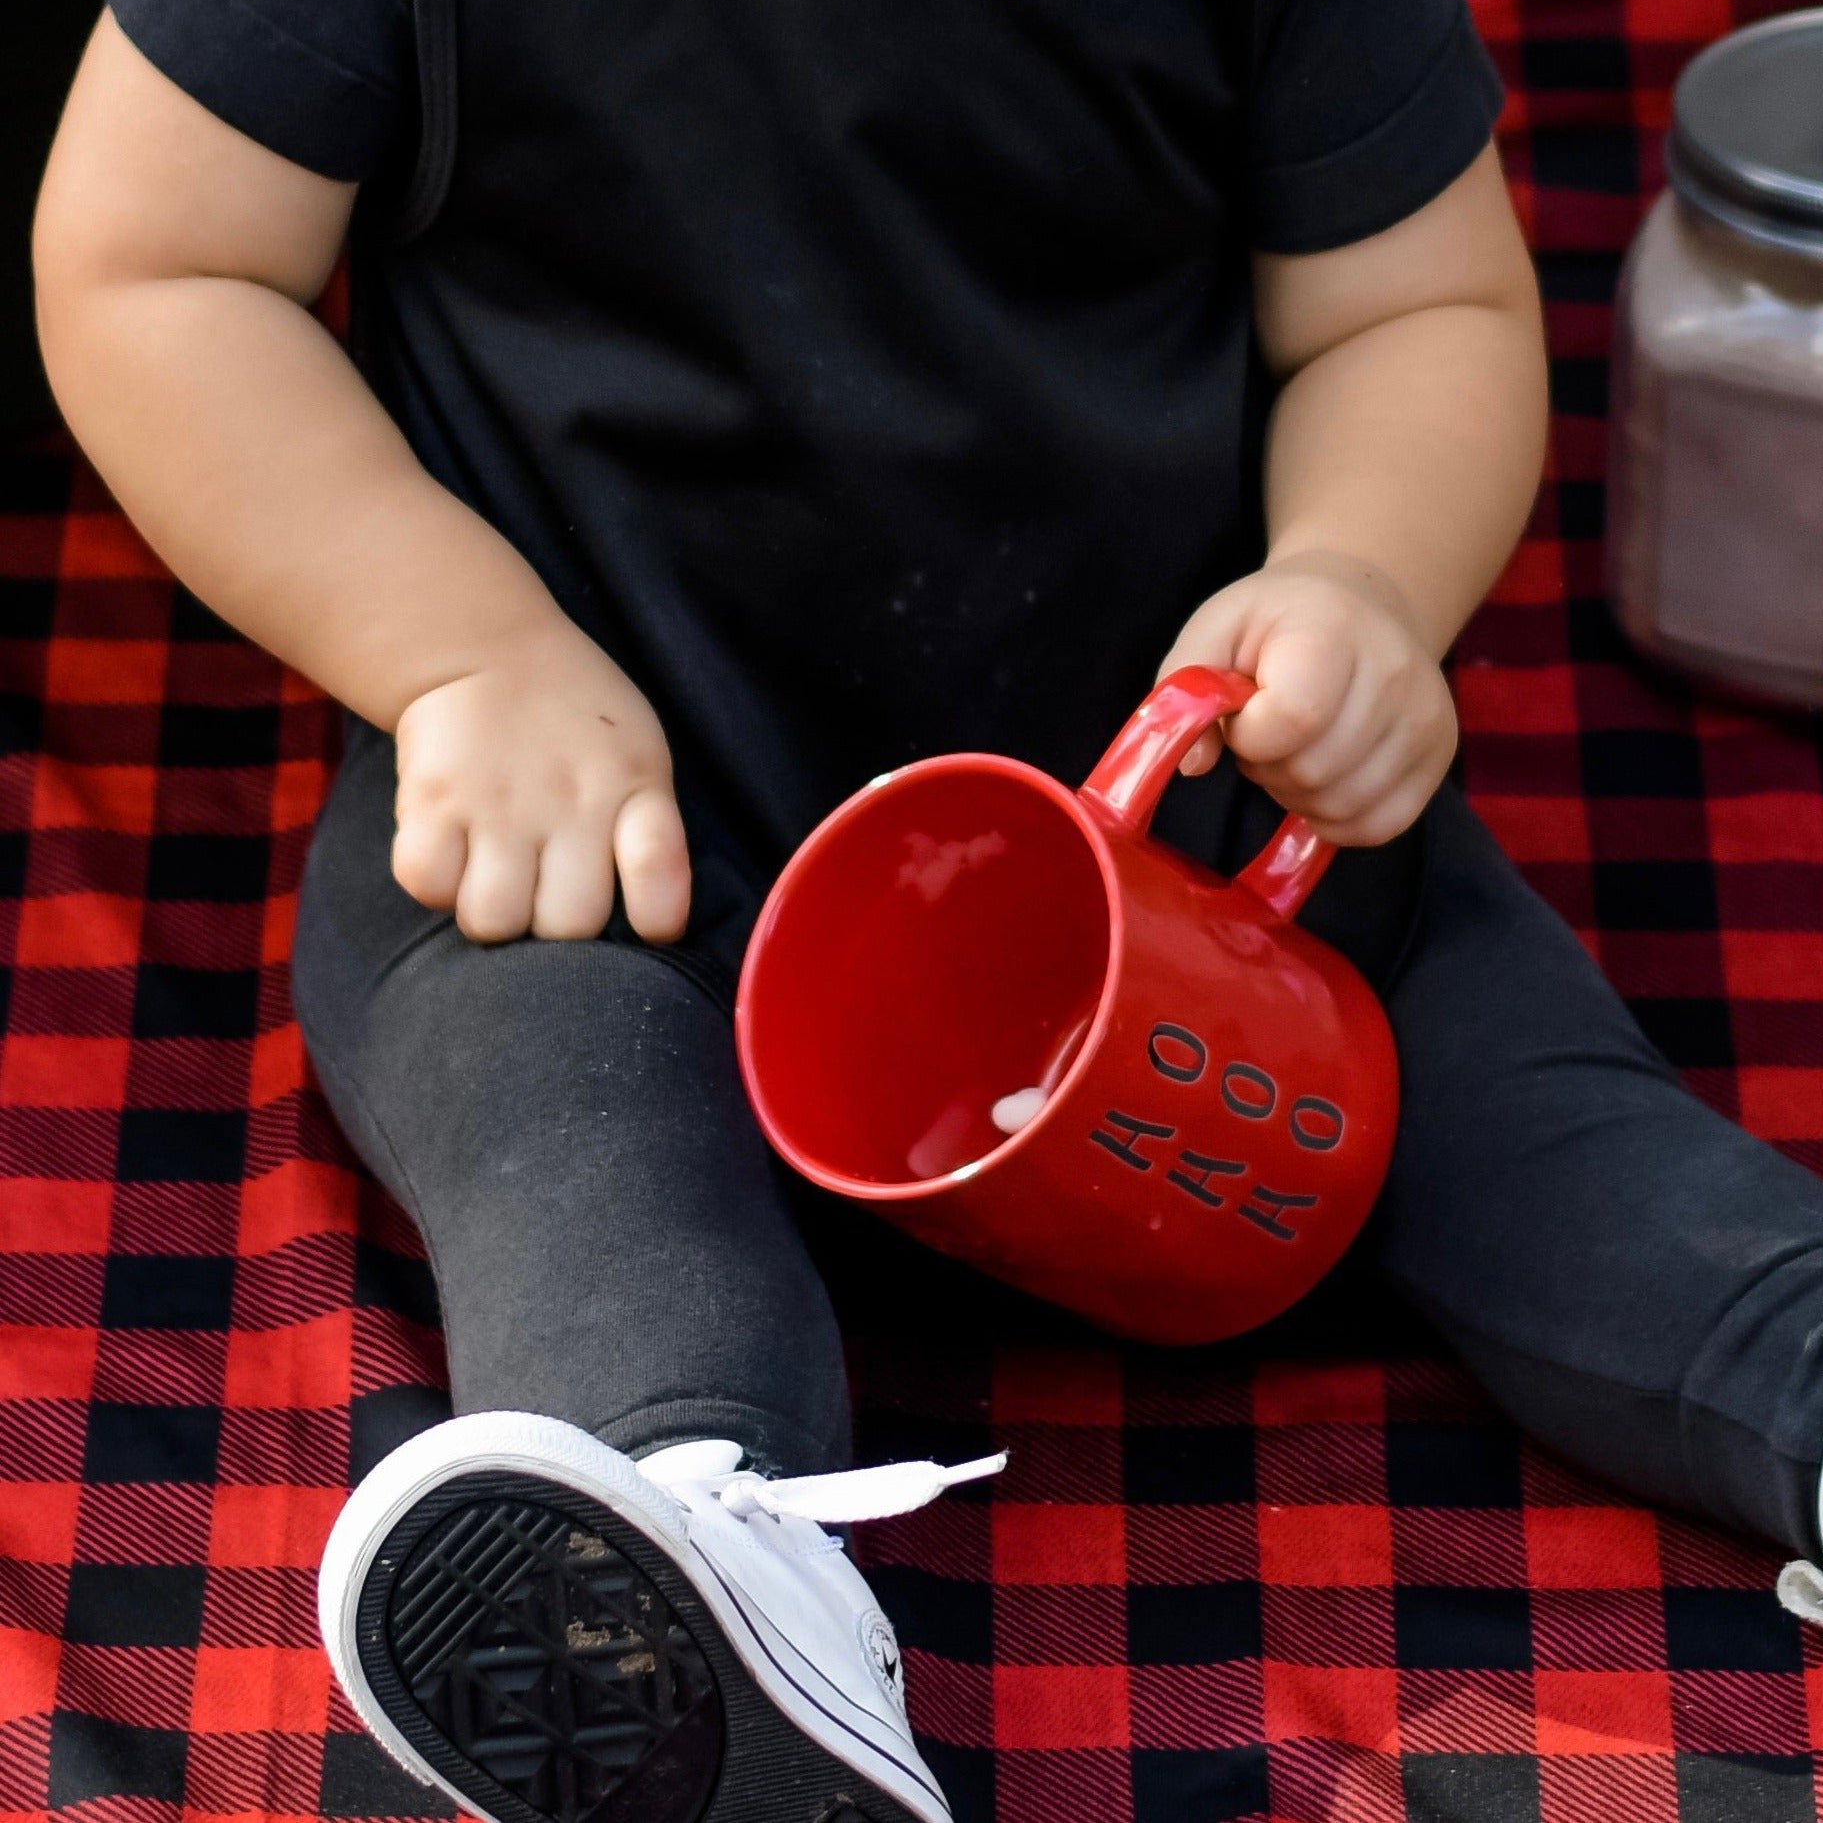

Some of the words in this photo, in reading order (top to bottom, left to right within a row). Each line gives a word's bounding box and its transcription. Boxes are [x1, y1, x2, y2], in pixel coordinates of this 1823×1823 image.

[1088, 1021, 1208, 1172] HO
[1165, 1061, 1278, 1208] HO
[1238, 1094, 1345, 1241] HO
